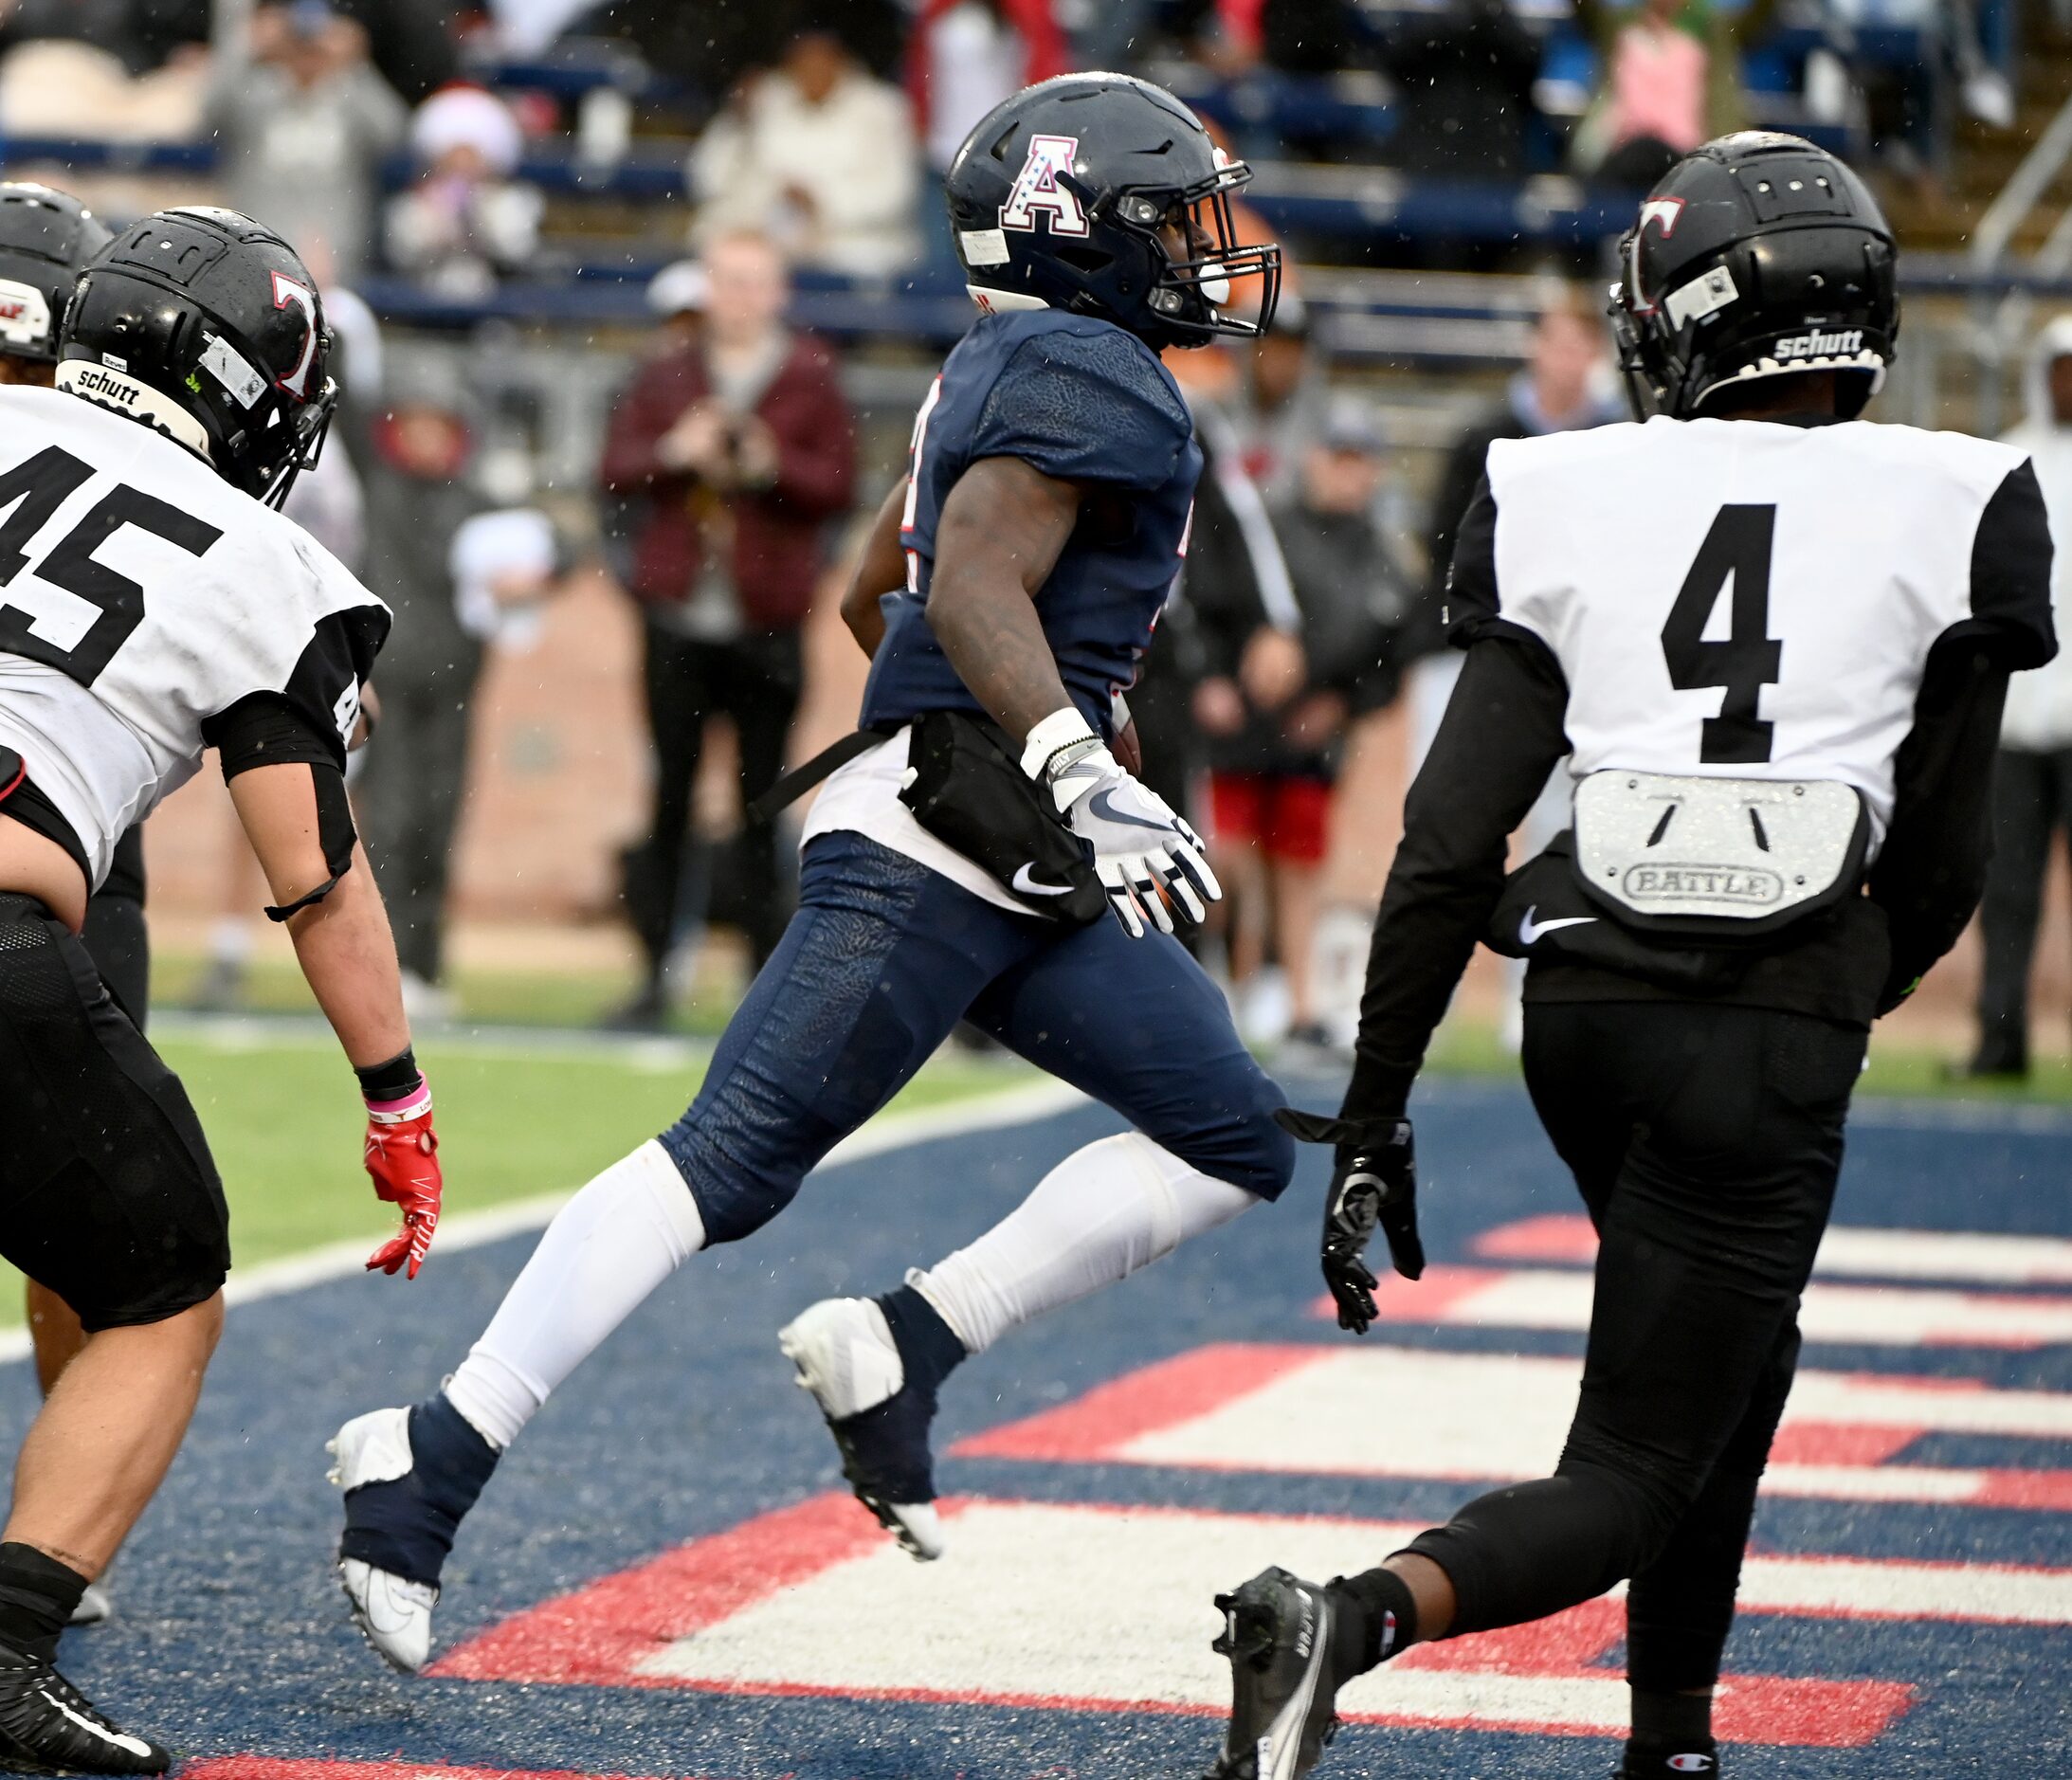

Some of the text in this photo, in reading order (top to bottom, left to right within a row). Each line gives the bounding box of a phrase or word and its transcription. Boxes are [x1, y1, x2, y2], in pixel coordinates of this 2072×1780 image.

[998, 134, 1089, 238] A
[1773, 328, 1863, 358] schutt
[78, 371, 139, 406] schutt
[1661, 503, 1783, 764] 4
[1637, 870, 1768, 898] BATTLE
[410, 1176, 437, 1262] VAPOR
